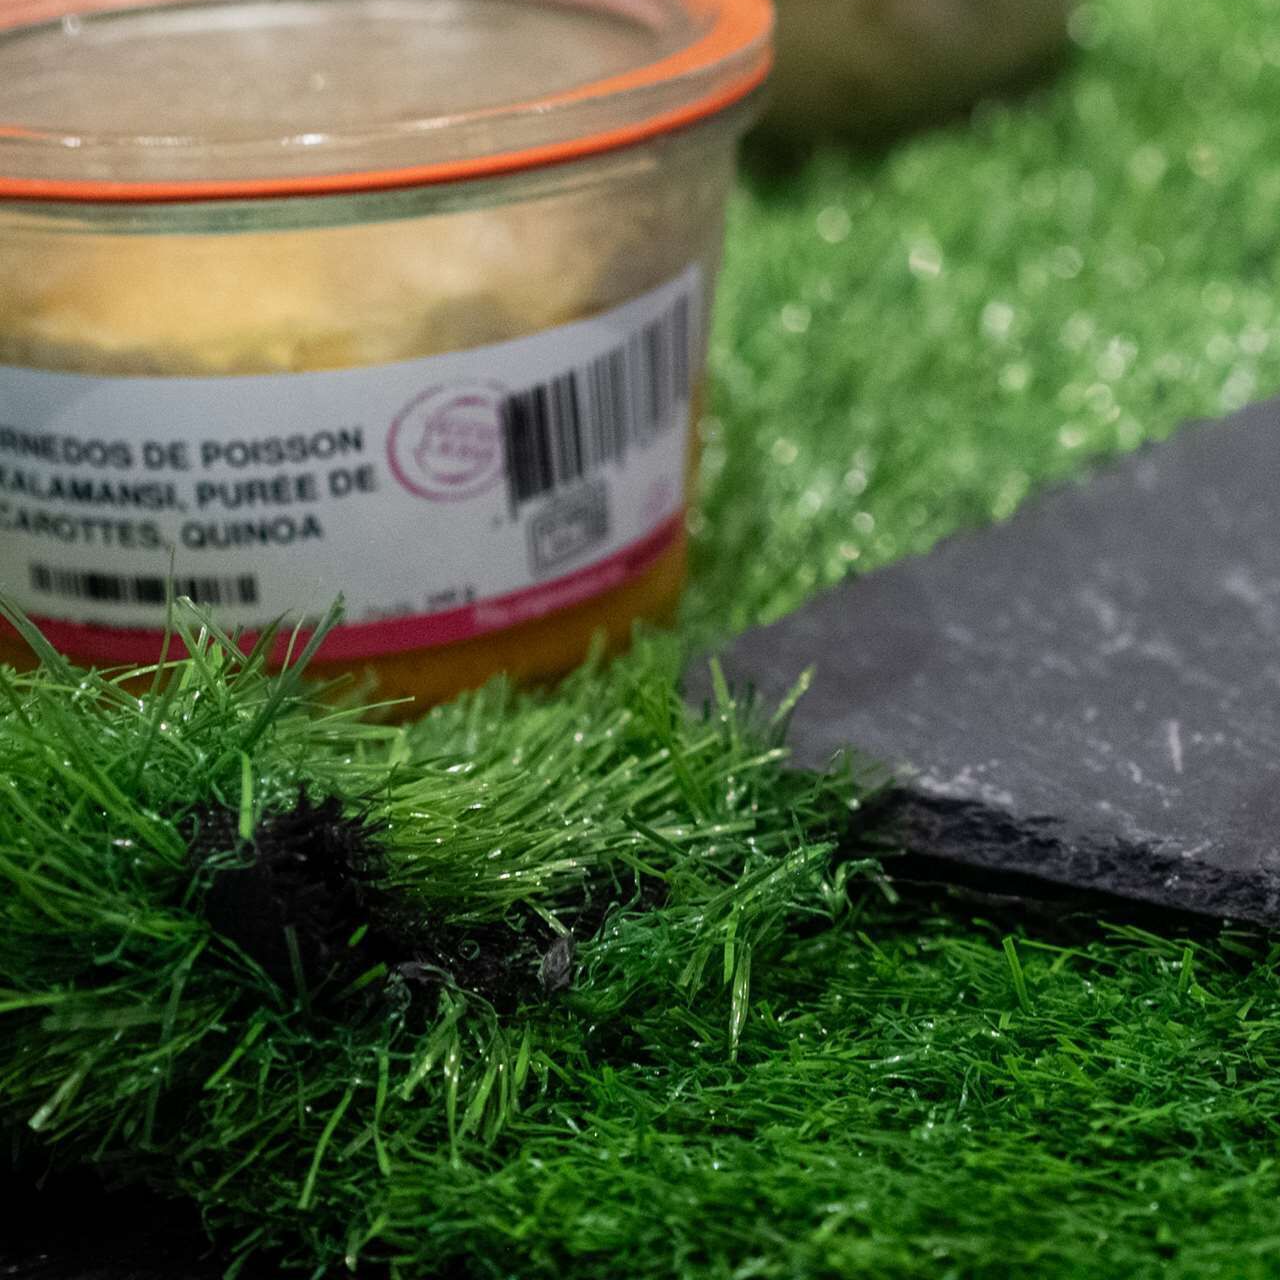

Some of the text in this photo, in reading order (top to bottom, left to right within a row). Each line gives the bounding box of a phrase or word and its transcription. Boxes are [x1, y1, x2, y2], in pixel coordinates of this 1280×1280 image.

[142, 439, 190, 470] DE
[200, 426, 364, 469] POISSON
[327, 462, 376, 499] DE
[180, 513, 322, 550] QUINOA
